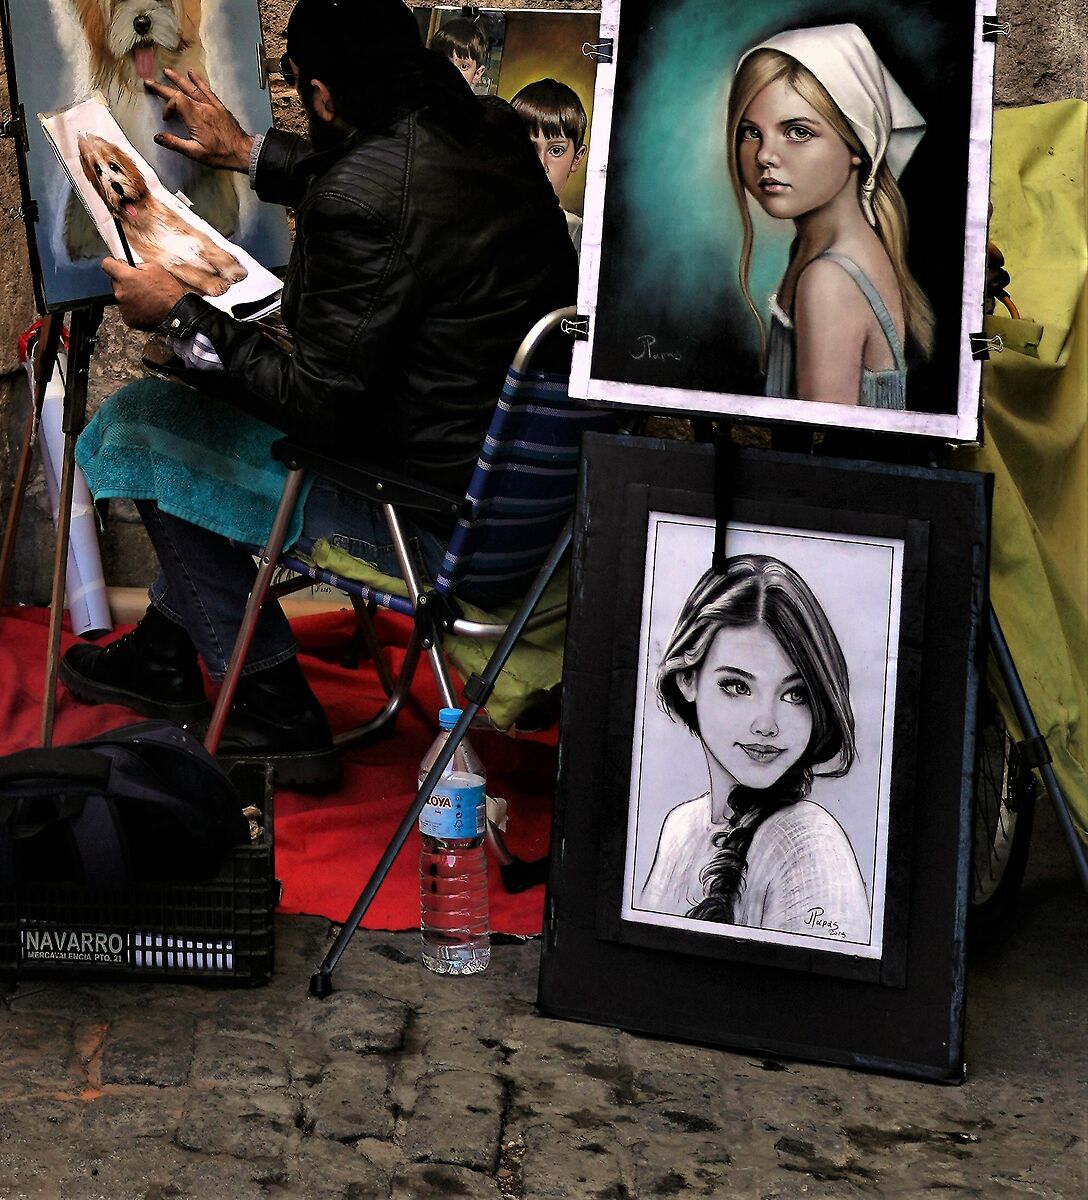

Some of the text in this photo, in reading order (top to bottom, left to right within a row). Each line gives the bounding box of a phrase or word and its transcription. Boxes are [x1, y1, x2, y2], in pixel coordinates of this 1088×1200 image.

[26, 931, 123, 954] NAVARRO
[27, 951, 92, 960] MERCAVALENCIA
[94, 953, 112, 962] PTO.
